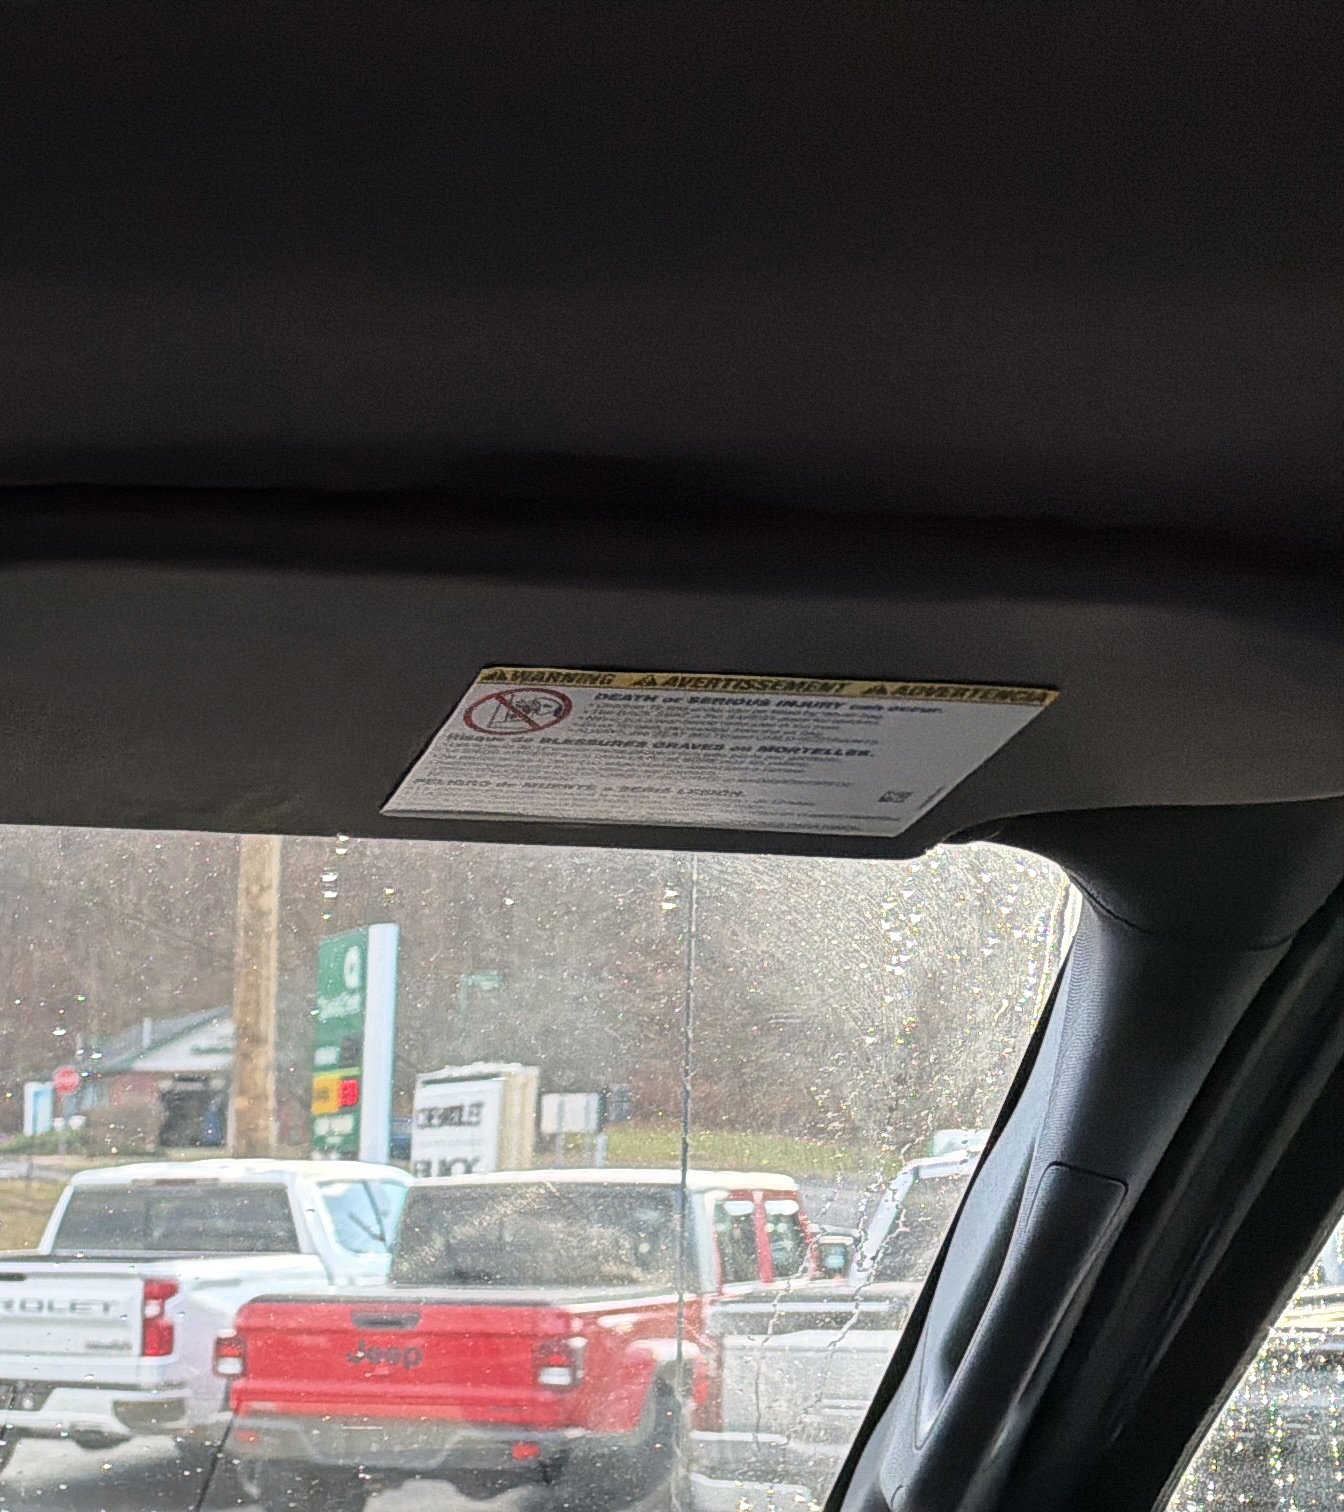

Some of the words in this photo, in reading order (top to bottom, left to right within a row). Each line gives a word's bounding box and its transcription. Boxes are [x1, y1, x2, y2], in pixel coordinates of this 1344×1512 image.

[512, 671, 617, 685] WARNING
[660, 675, 846, 693] AVERTISSEMENT
[345, 1340, 424, 1371] Jeep
